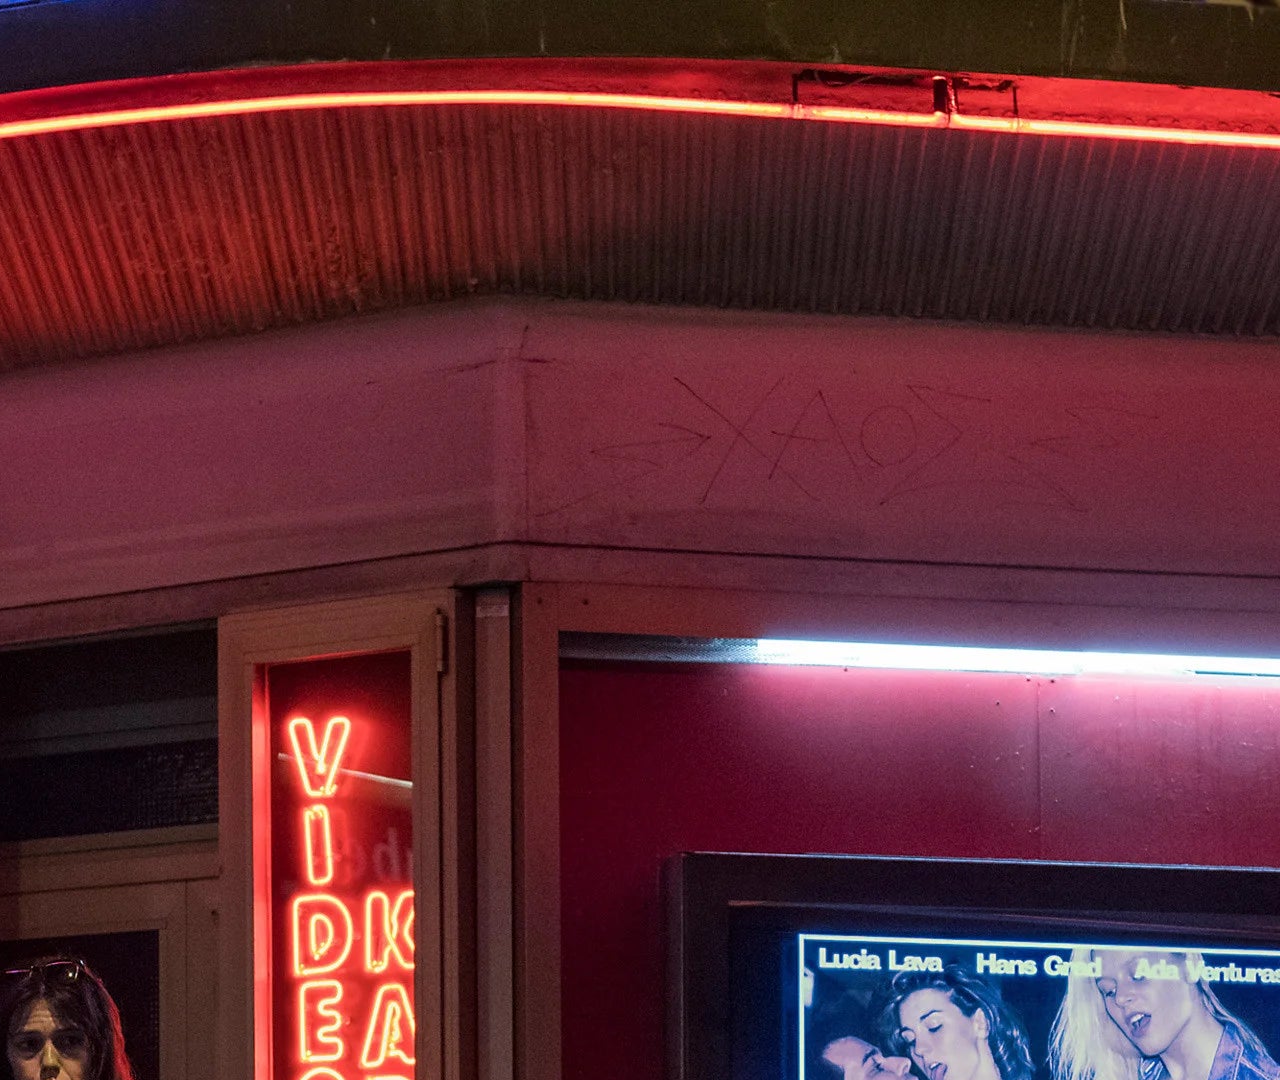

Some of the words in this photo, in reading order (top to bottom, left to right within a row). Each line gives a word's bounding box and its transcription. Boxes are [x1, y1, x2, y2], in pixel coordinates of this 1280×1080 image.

[819, 947, 882, 970] Lucia
[888, 949, 944, 972] Lava
[976, 952, 1037, 975] Hans
[1133, 958, 1181, 980] Ada
